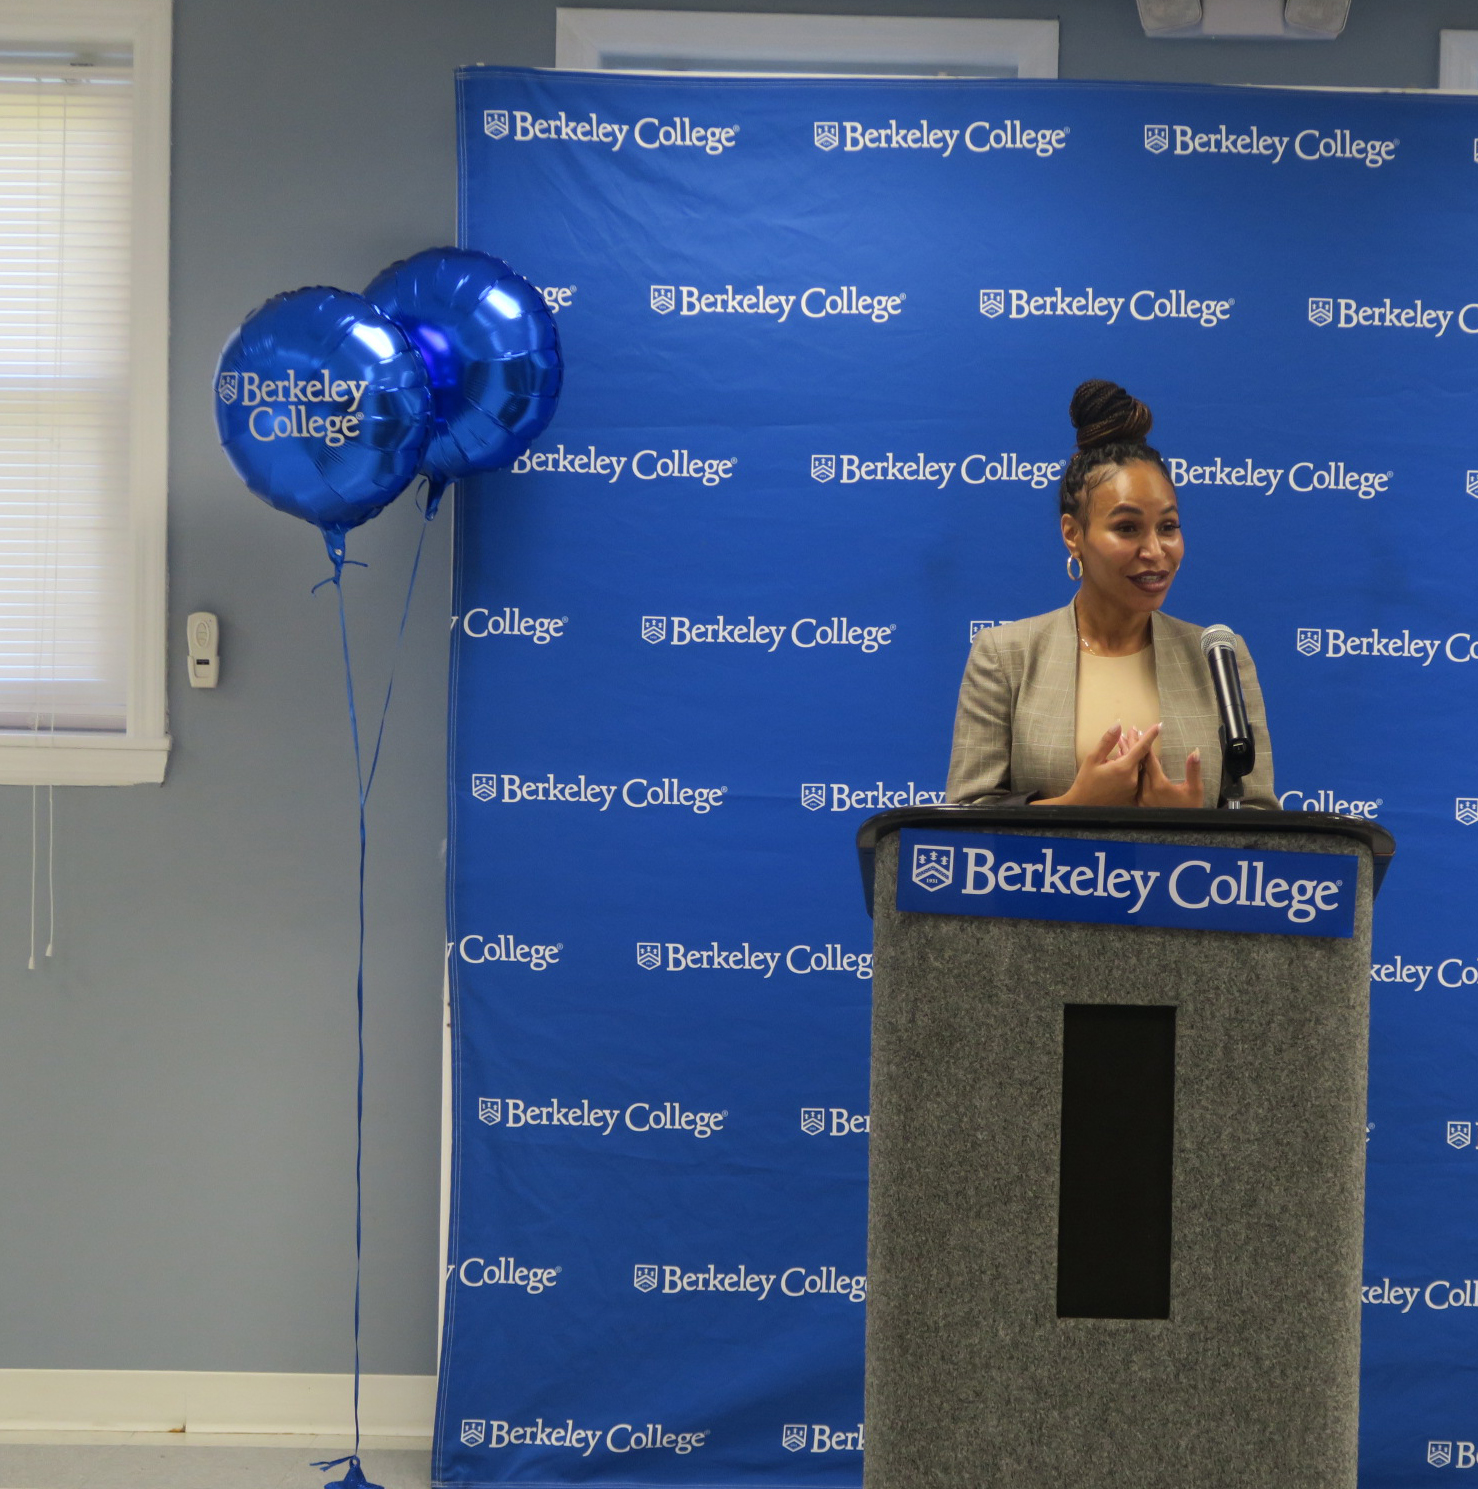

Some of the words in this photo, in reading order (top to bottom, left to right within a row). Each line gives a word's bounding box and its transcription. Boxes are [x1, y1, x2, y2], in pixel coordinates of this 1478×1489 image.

[513, 110, 630, 152] Berkeley
[842, 119, 960, 158] Berkeley
[1172, 124, 1290, 164] Berkeley
[679, 284, 797, 323] Berkeley
[1008, 286, 1125, 325] Berkeley
[1337, 298, 1454, 338] Berkeley
[242, 369, 368, 411] Berkeley
[513, 446, 629, 484] Berkeley
[839, 452, 957, 490] Berkeley
[1169, 457, 1285, 498] Berkeley
[670, 615, 787, 653] Berkeley
[1325, 628, 1442, 667] Berkeley
[500, 773, 618, 812] Berkeley
[961, 847, 1161, 914] Berkeley
[665, 941, 782, 979] Berkeley
[505, 1098, 621, 1136] Berkeley
[662, 1264, 777, 1301] Berkeley
[488, 1418, 603, 1457] Berkeley
